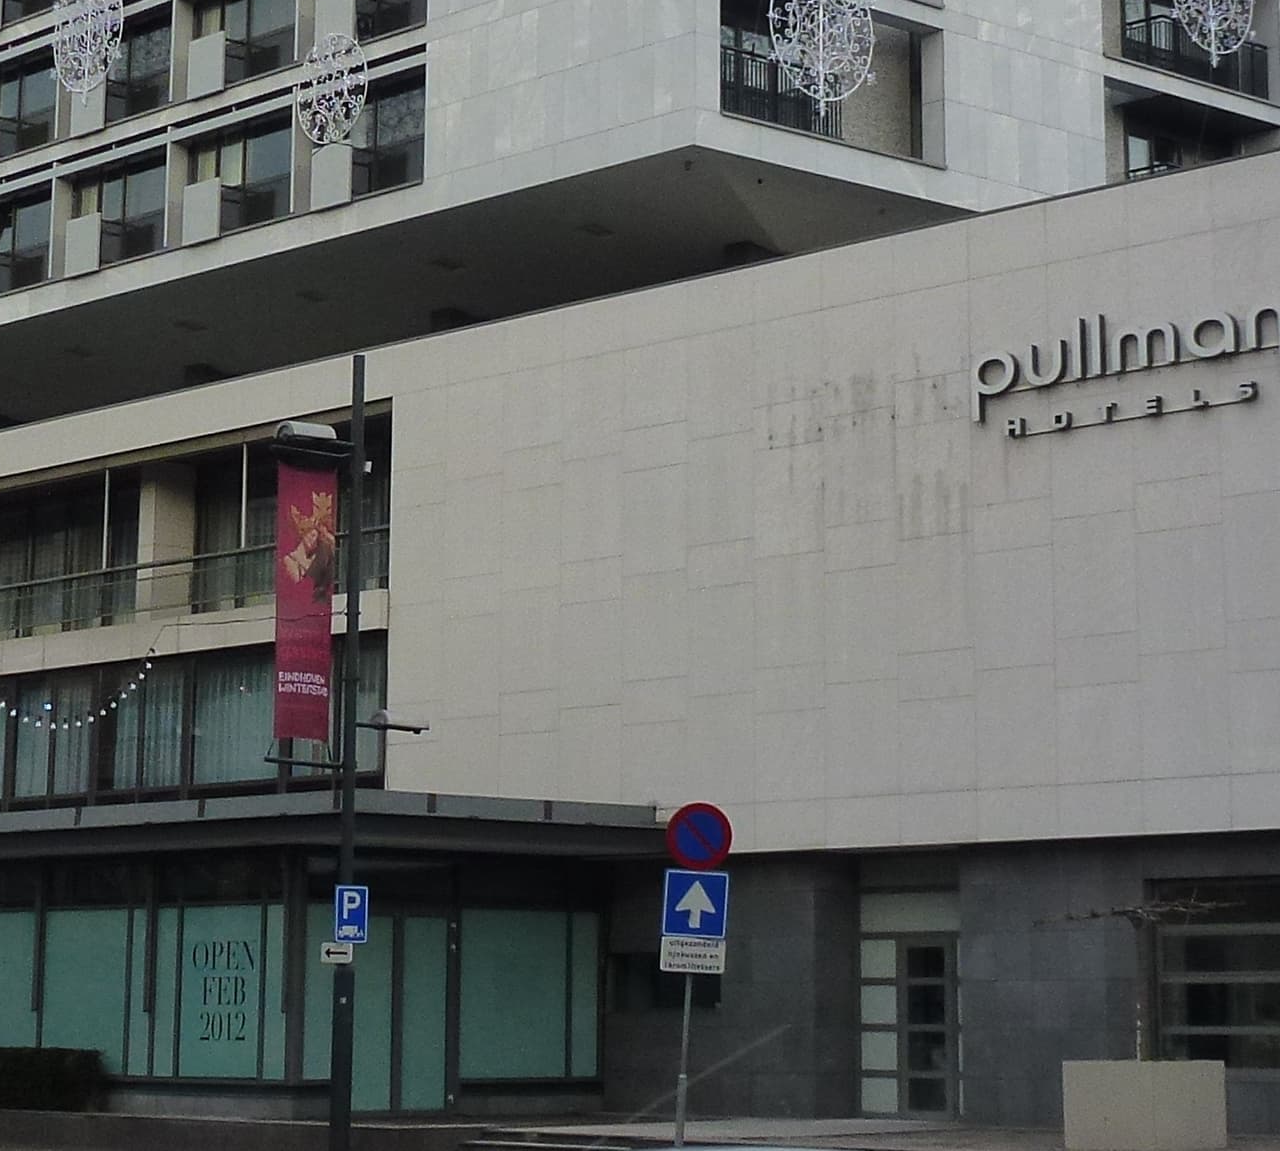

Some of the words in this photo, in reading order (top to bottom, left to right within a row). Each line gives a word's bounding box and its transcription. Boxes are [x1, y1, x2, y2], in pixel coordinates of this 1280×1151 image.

[1006, 380, 1258, 438] HOTELS
[278, 671, 325, 684] EINDHOVEN
[343, 890, 361, 919] P
[192, 940, 257, 970] OPEN
[203, 976, 246, 1005] FEB
[199, 1012, 246, 1041] 2012
